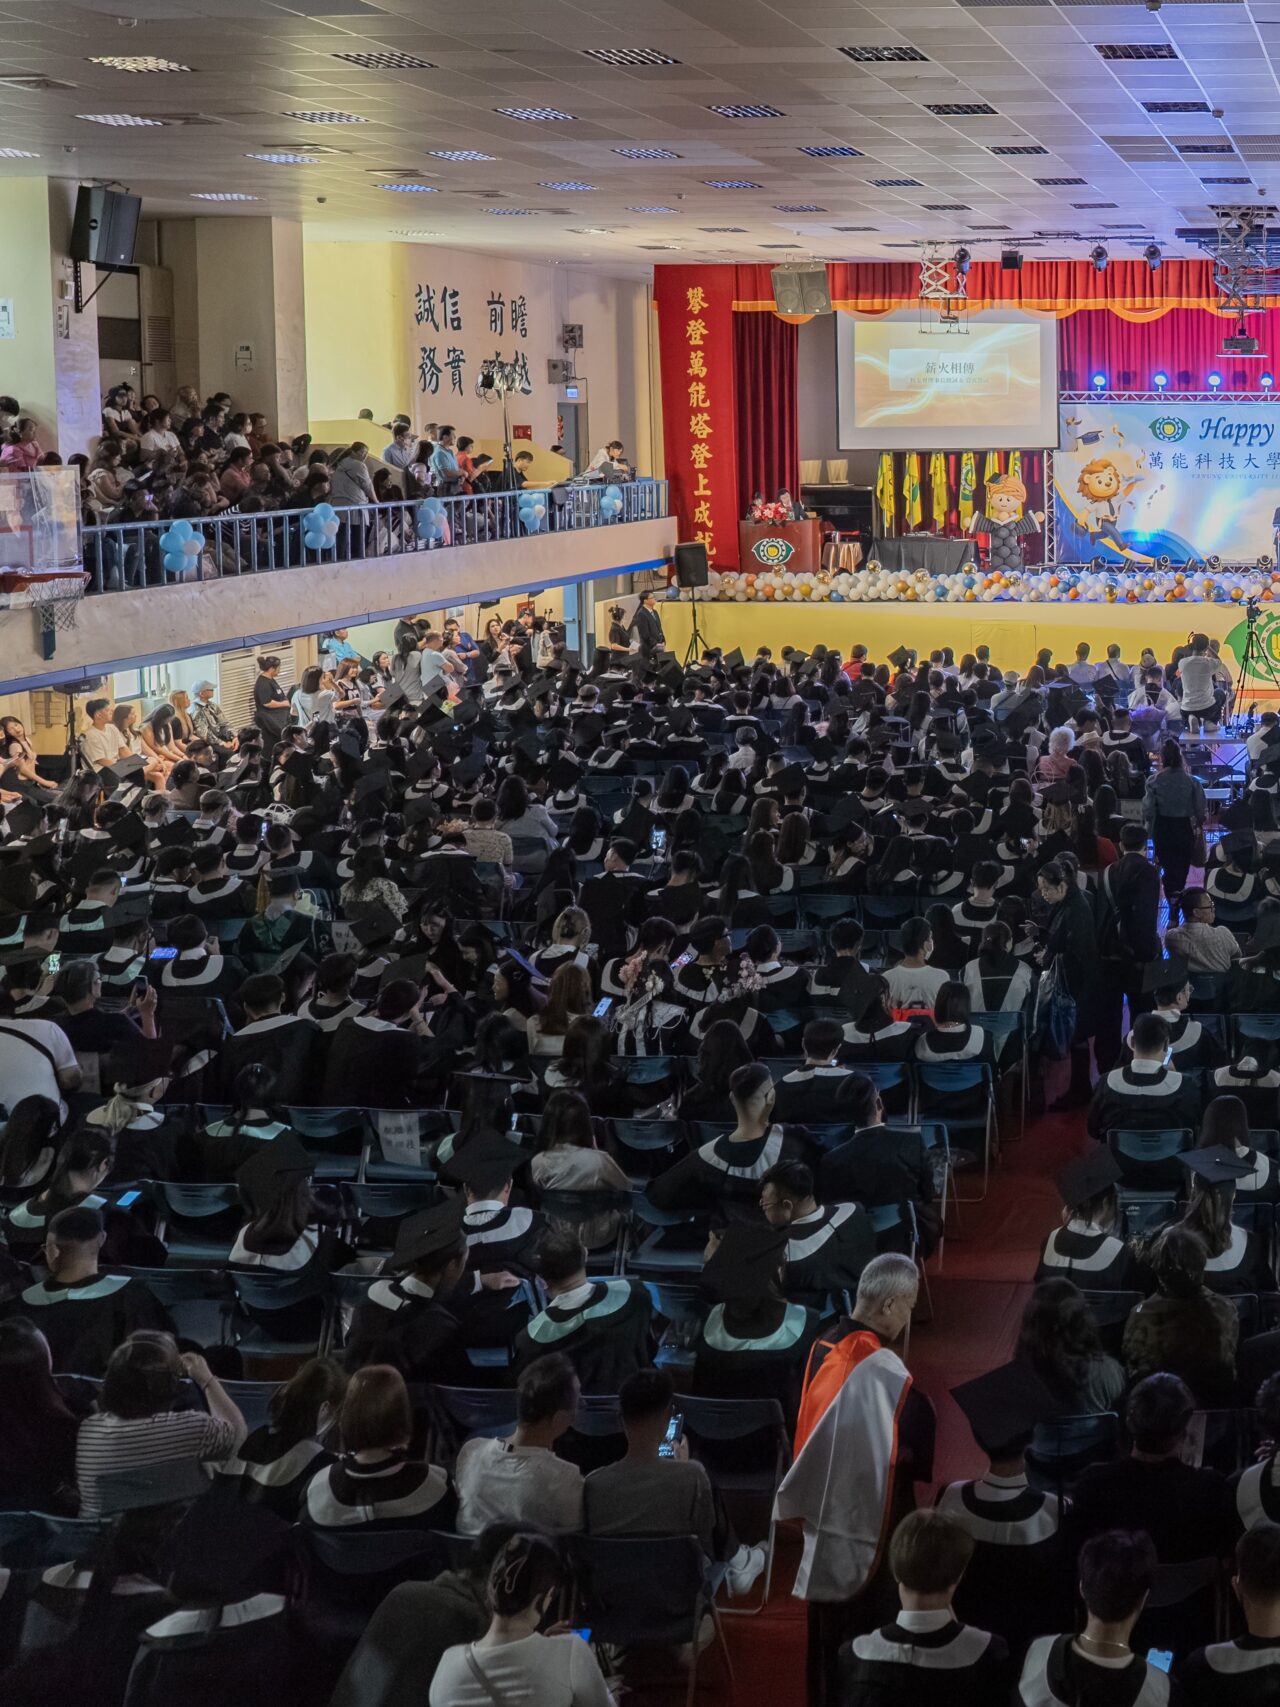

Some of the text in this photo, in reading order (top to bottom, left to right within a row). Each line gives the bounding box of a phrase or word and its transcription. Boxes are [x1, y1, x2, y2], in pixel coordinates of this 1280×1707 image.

[415, 284, 528, 338] 誠信 前瞻
[418, 346, 466, 397] 務實
[926, 361, 975, 375] 薪火相傳
[685, 286, 716, 565] 攀登萬能塔登上成就
[1199, 416, 1275, 447] Happy
